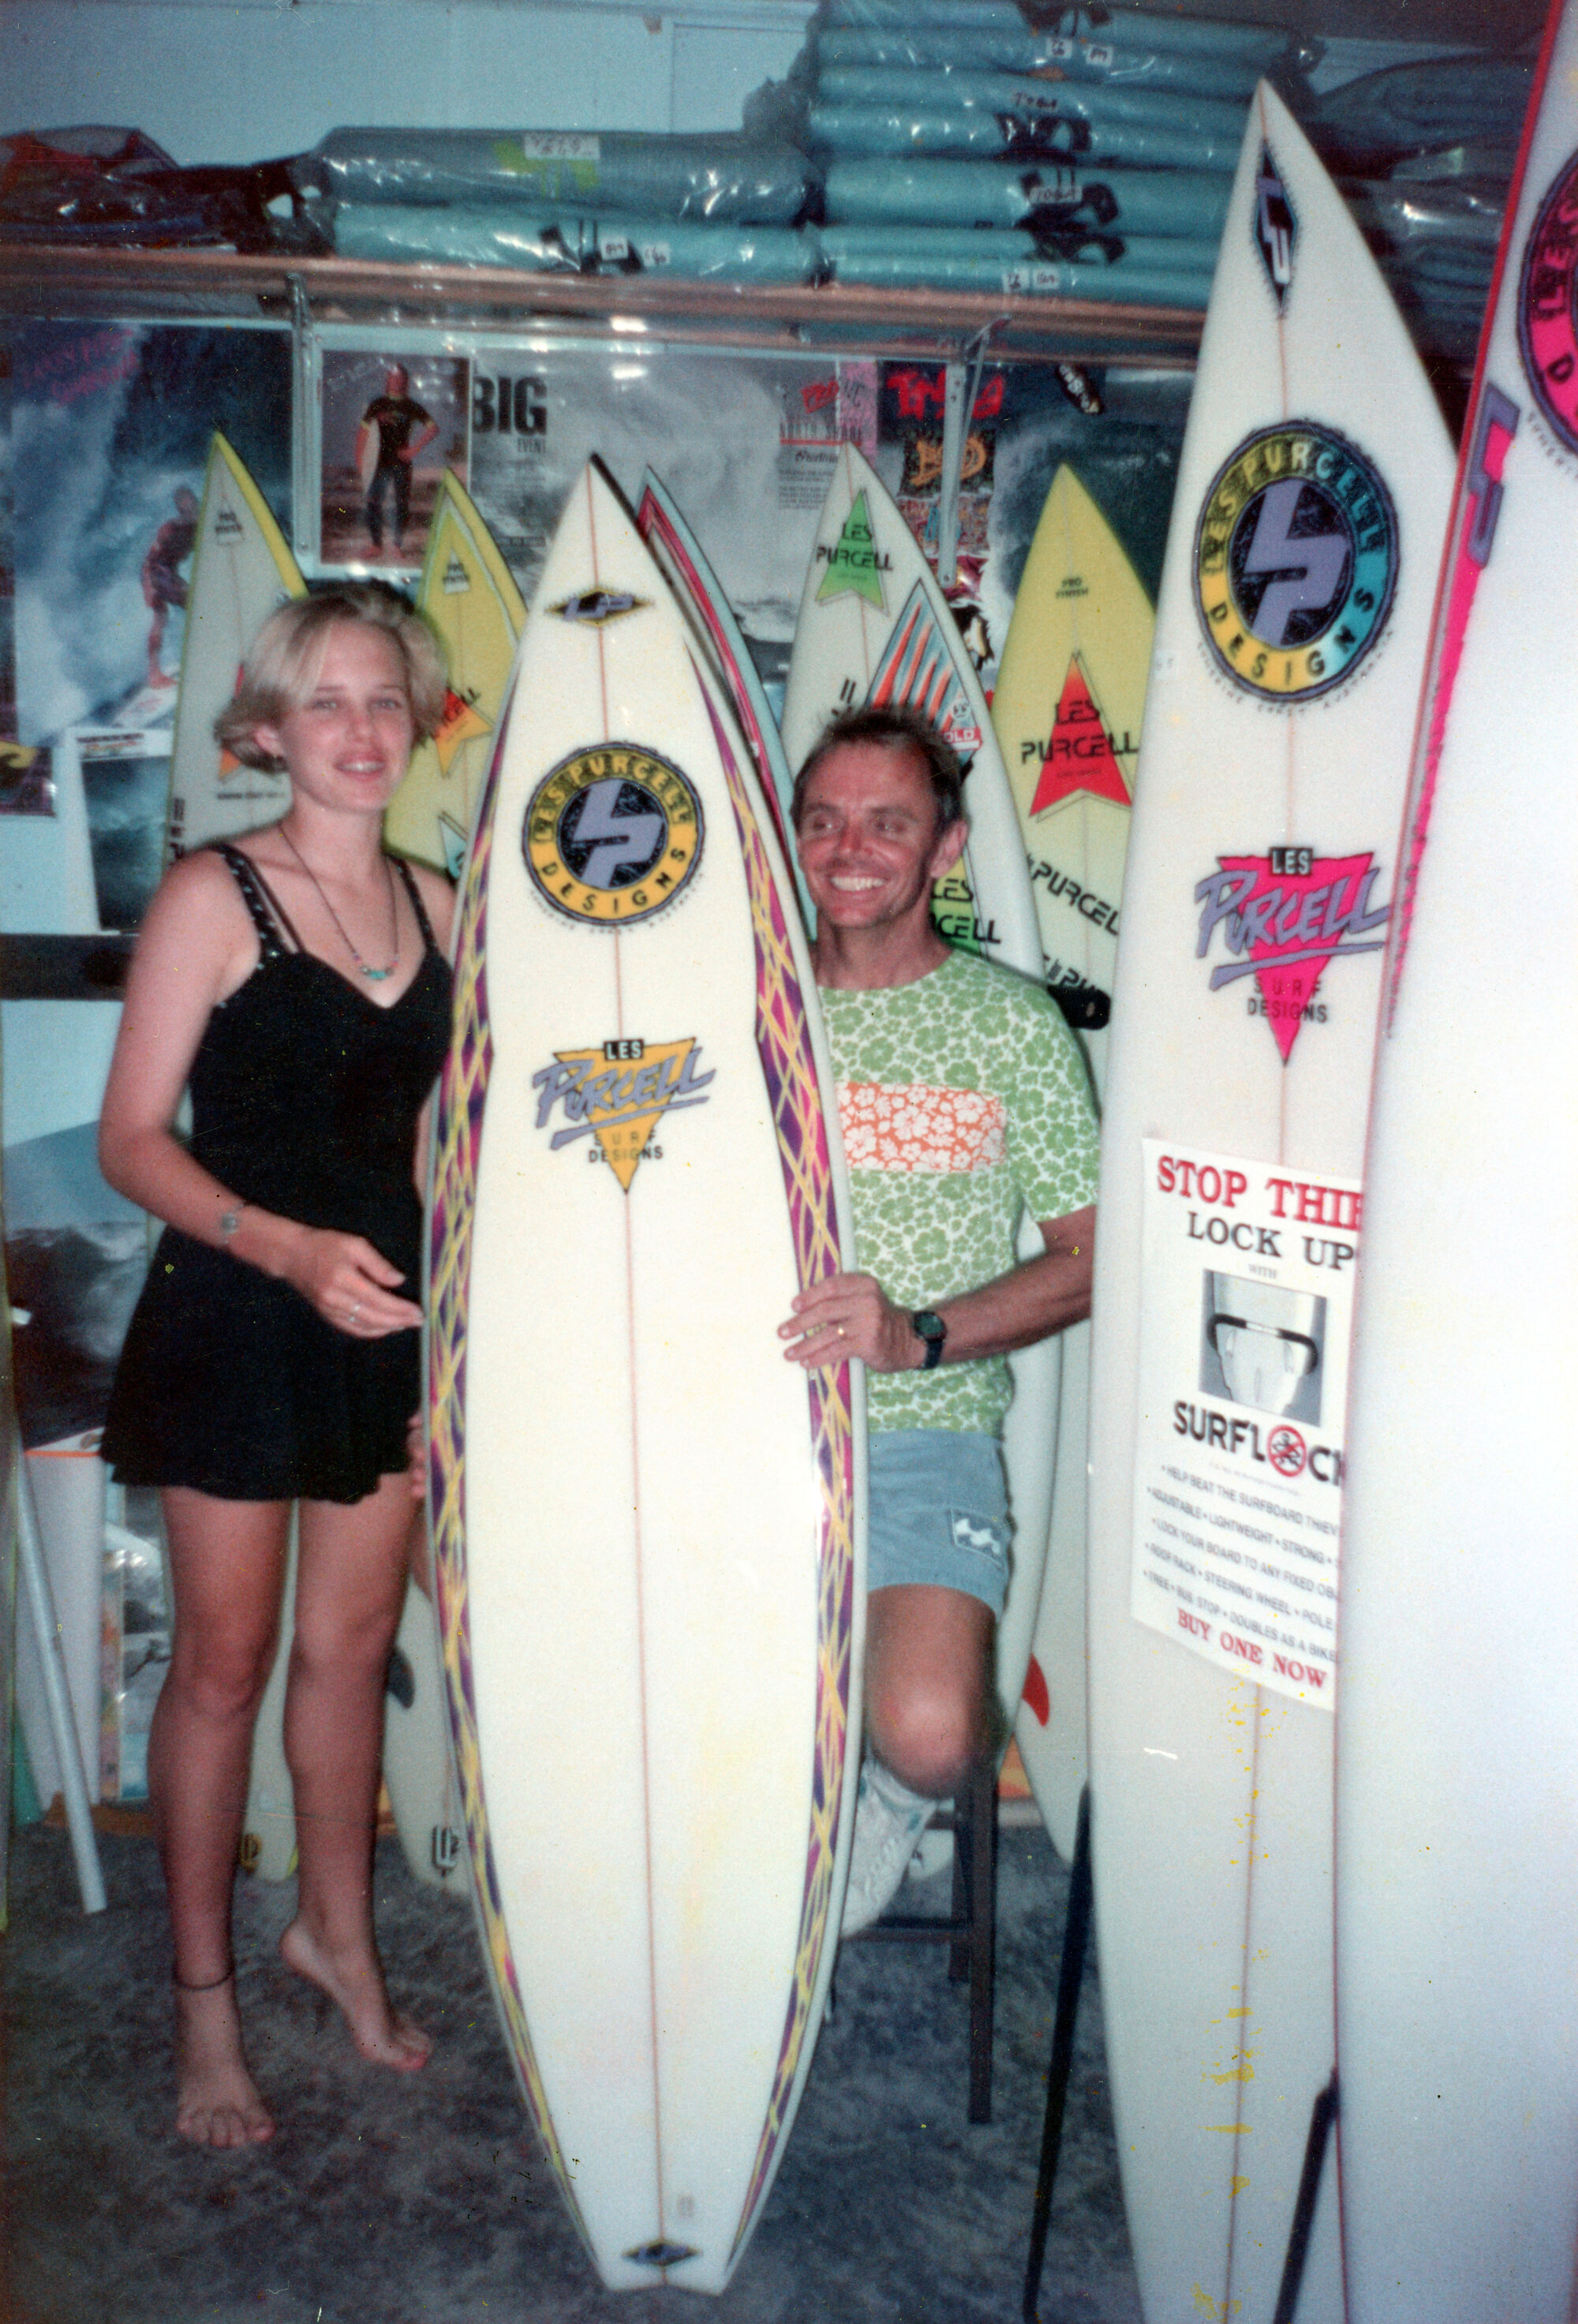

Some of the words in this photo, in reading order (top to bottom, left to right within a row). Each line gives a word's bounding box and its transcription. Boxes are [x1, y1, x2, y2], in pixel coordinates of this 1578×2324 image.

[472, 376, 547, 436] BIG
[518, 438, 546, 453] EVENT
[817, 546, 893, 571] PURCELL
[842, 523, 872, 542] LES
[1210, 589, 1374, 685] DESIGNS
[1055, 700, 1100, 725] LES
[1021, 732, 1139, 764] PURCELL
[569, 753, 690, 824] PURCELL
[541, 848, 686, 914] DESIGNS
[1272, 850, 1311, 874] LES
[1247, 997, 1328, 1023] DESIGNS
[606, 1041, 642, 1060] LES
[589, 1146, 663, 1163] DESIGNS
[1157, 1155, 1247, 1207] STOP
[1187, 1211, 1281, 1258] LOCK
[1302, 1236, 1355, 1271] UP
[1248, 1263, 1277, 1279] WITH
[1167, 1466, 1188, 1482] HELP
[1191, 1474, 1214, 1492] BEAT
[1217, 1484, 1237, 1502] THE
[1239, 1491, 1303, 1525] SURFBOARD
[1153, 1488, 1201, 1519] ADJUSTABLE
[1209, 1512, 1273, 1544] LIGHTWEIGHT
[1282, 1538, 1325, 1563] STRONG
[1157, 1518, 1179, 1537] LOCK
[1181, 1529, 1204, 1548] YOUR
[1206, 1541, 1242, 1564] BOARD
[1244, 1554, 1258, 1571] TO
[1262, 1562, 1281, 1578] ANY
[1284, 1570, 1315, 1592] FIXED
[1149, 1570, 1170, 1590] TREE
[1176, 1585, 1193, 1604] BUS
[1197, 1596, 1221, 1615] STOP
[1229, 1611, 1278, 1641] DOUBLES
[1281, 1632, 1296, 1648] AS
[1298, 1639, 1306, 1652] A
[1150, 1543, 1172, 1562] ROOF
[1173, 1555, 1196, 1576] RACK
[1205, 1570, 1252, 1600] STEERING
[1256, 1590, 1291, 1615] WHEEL
[1303, 1609, 1333, 1631] POLE
[1178, 1607, 1212, 1641] BUY
[1219, 1630, 1262, 1664] ONE
[1273, 1652, 1327, 1688] NOW
